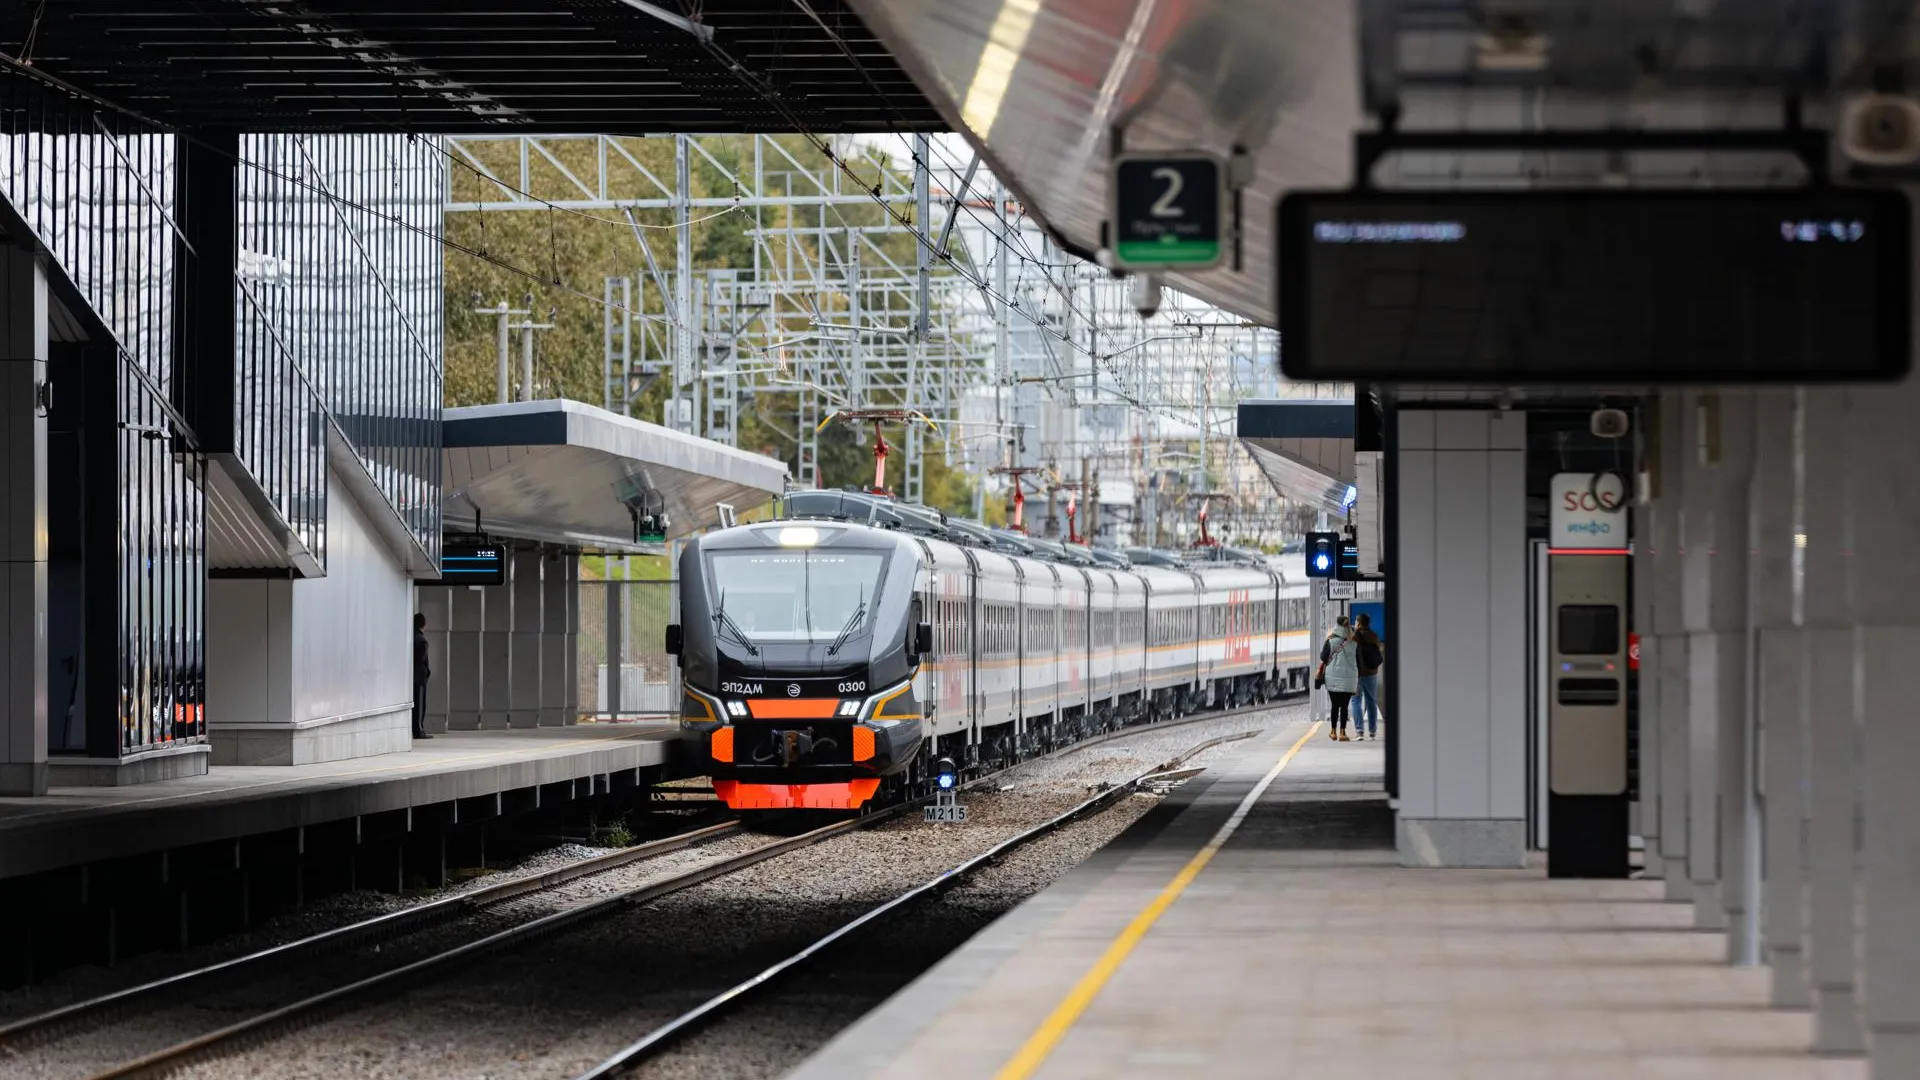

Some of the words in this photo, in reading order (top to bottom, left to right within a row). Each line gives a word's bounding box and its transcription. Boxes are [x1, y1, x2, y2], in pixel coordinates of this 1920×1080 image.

[1151, 166, 1184, 217] 2
[1564, 491, 1615, 511] SOS
[721, 681, 763, 695] ЭП2ДМ
[838, 681, 866, 693] 0300
[926, 807, 965, 820] М215
